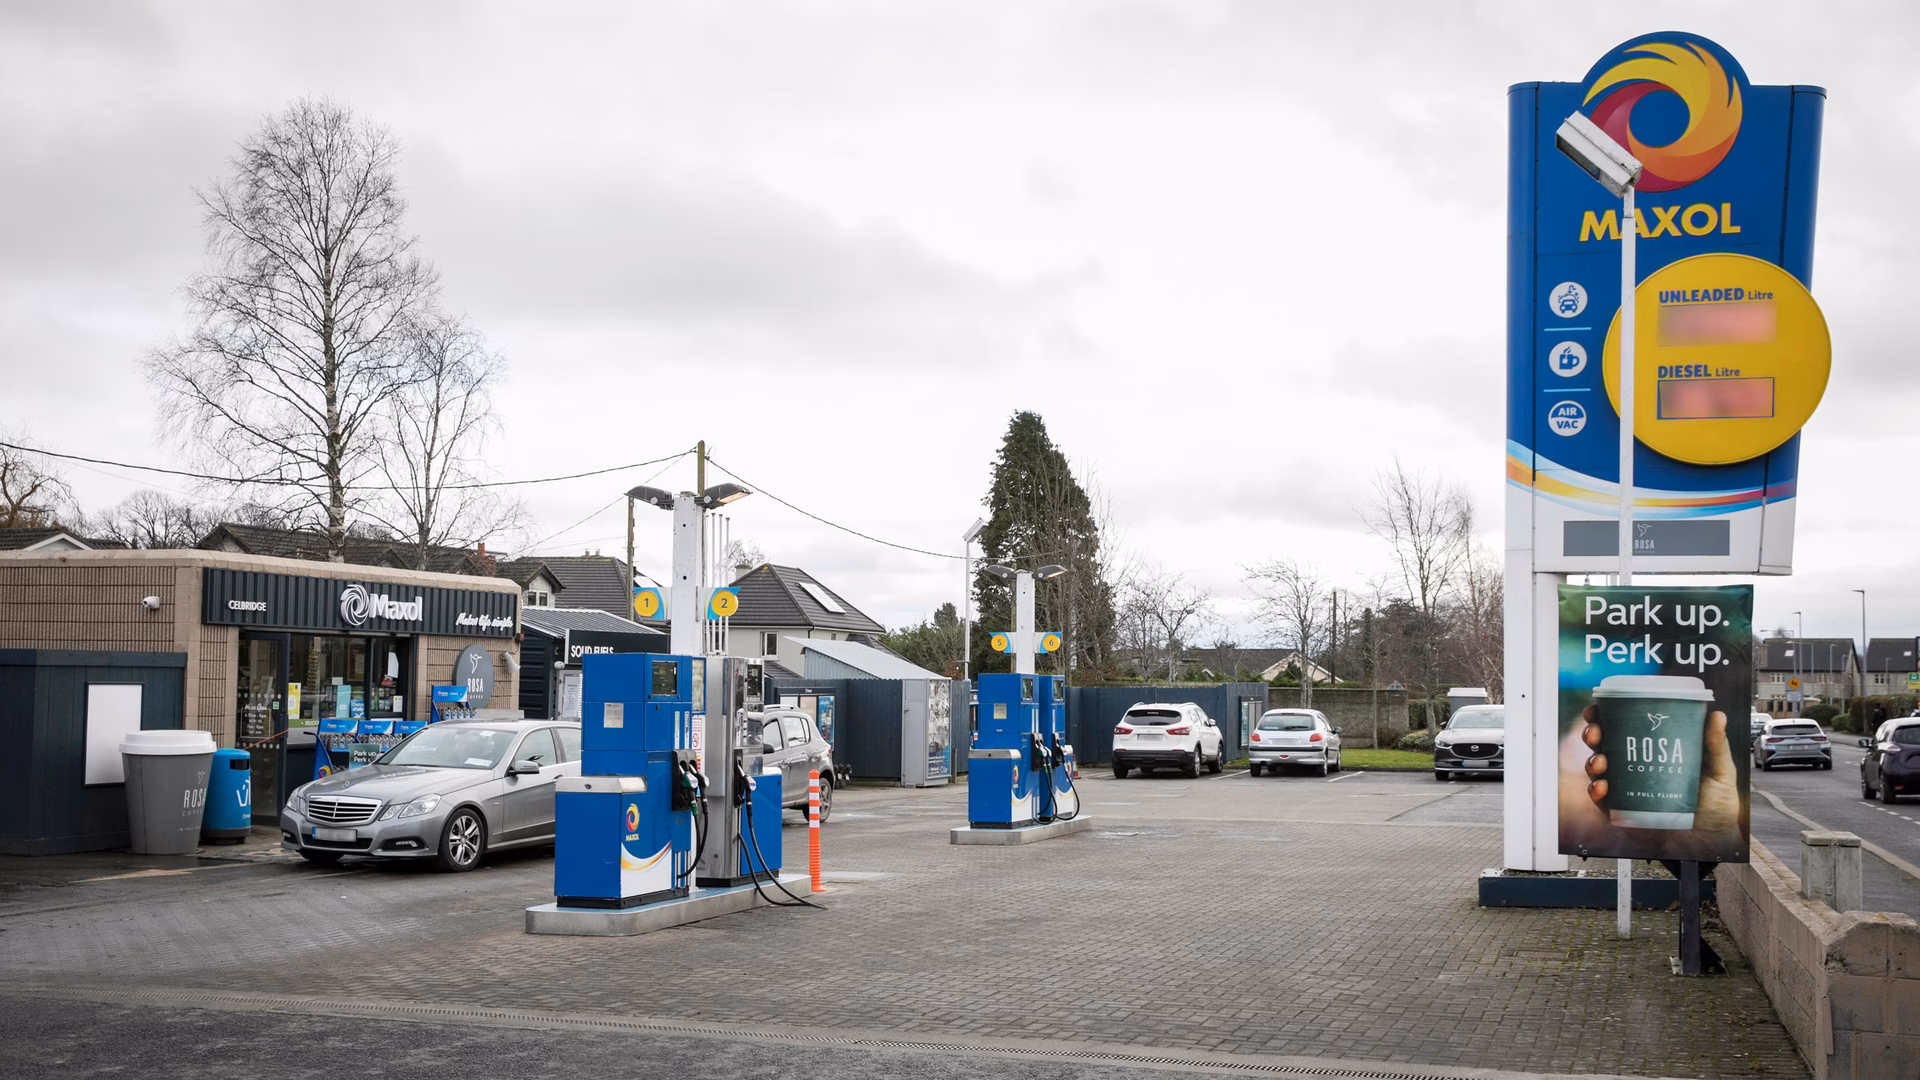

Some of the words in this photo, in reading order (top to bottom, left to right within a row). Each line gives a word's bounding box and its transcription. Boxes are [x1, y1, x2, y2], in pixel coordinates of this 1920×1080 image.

[1579, 202, 1741, 242] MAXOL
[1659, 288, 1745, 304] UNLEADED
[1748, 291, 1774, 300] Litre
[1657, 364, 1712, 379] DIESEL
[1715, 367, 1740, 377] Litre
[1558, 407, 1577, 416] AIR
[1556, 420, 1579, 429] VAC
[1634, 539, 1655, 549] ROSA
[227, 599, 267, 612] CELBRIDGE
[368, 593, 423, 622] Maxol
[643, 597, 650, 608] 1
[721, 598, 728, 609] 2
[1585, 595, 1663, 626] Park
[1675, 604, 1730, 634] up.
[997, 639, 1003, 647] 5
[1048, 639, 1054, 647] 6
[1585, 633, 1663, 664] Perk
[1675, 643, 1730, 673] up.
[467, 678, 484, 693] ROSA
[1626, 736, 1683, 763] ROSA
[1627, 765, 1683, 773] COFFEE
